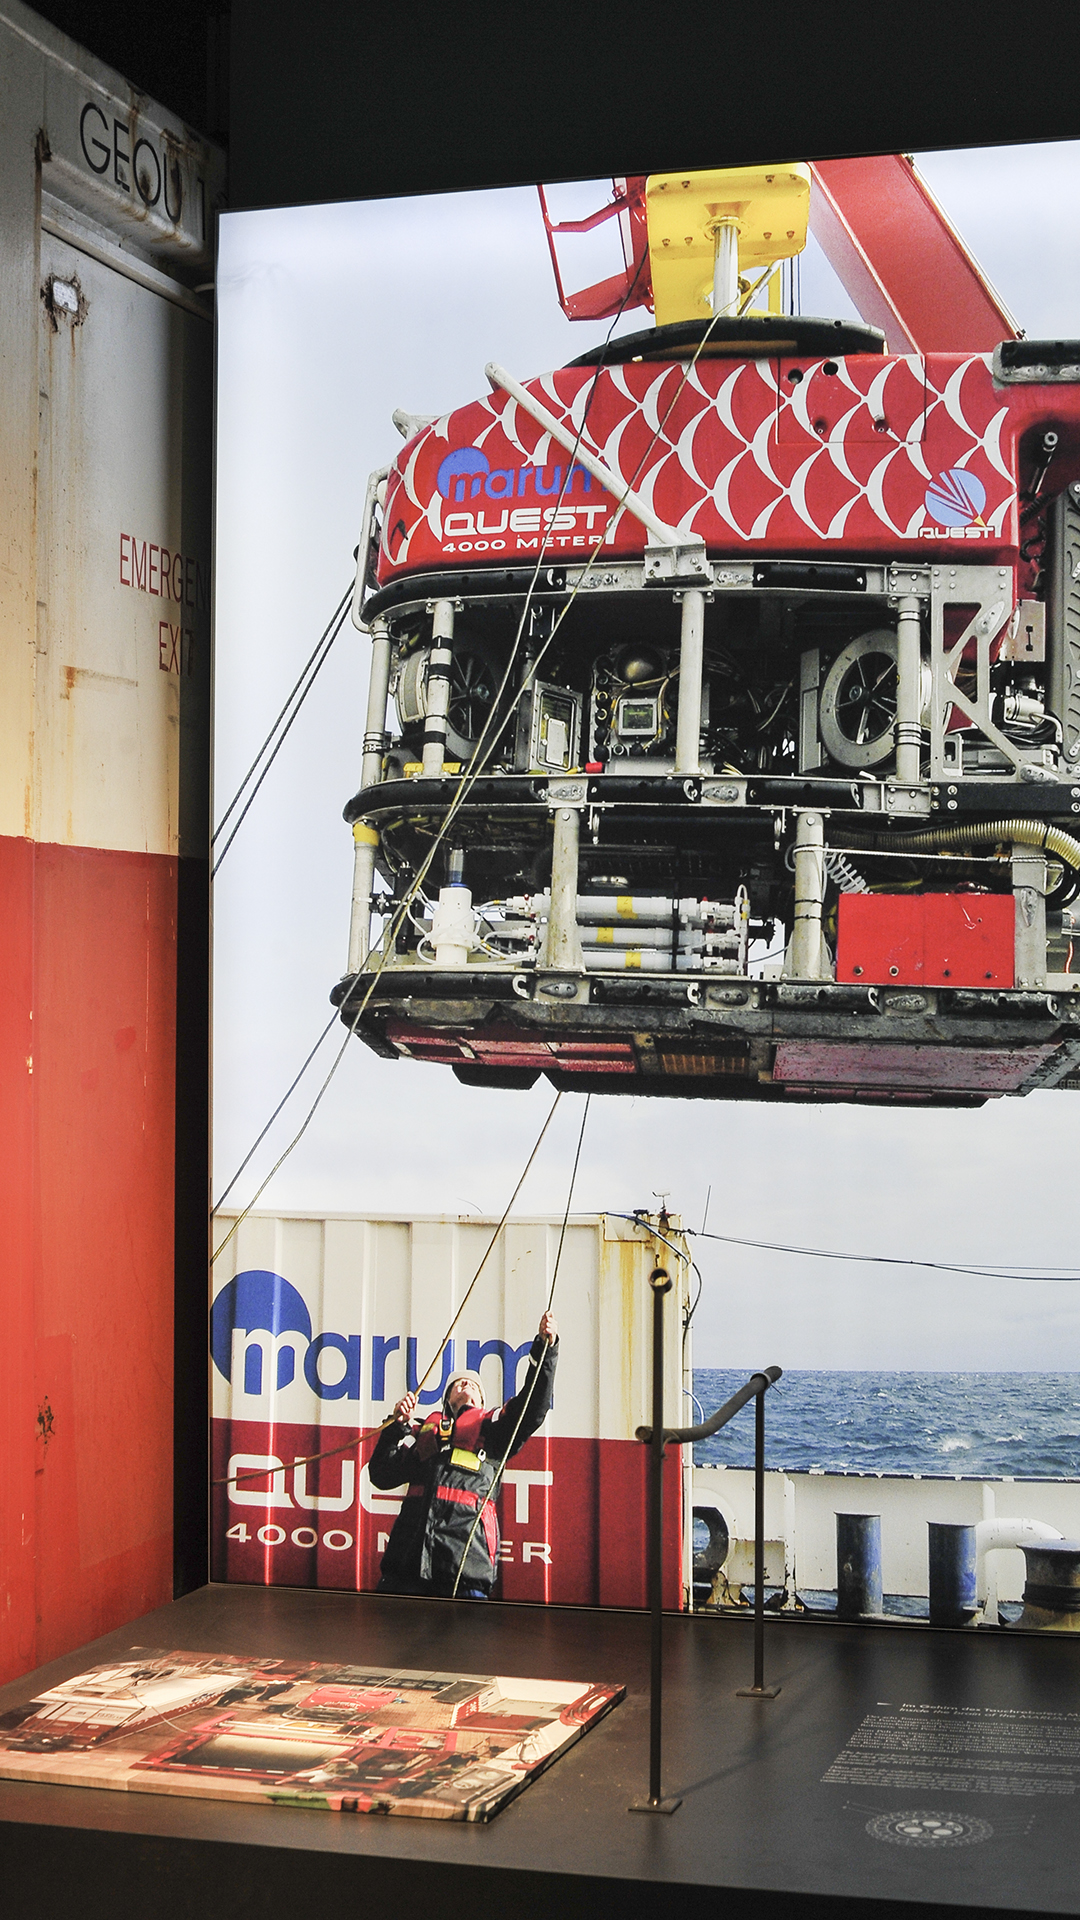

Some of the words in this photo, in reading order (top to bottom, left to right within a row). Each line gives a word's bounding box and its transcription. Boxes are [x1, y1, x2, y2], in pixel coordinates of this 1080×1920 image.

[80, 102, 182, 223] GEOU
[444, 505, 607, 536] QUEST
[919, 526, 994, 539] QUEST
[442, 540, 506, 552] 4000
[516, 535, 603, 549] METER
[120, 533, 211, 611] EMERGEN
[159, 620, 193, 677] EXIT
[225, 1523, 353, 1551] 4000
